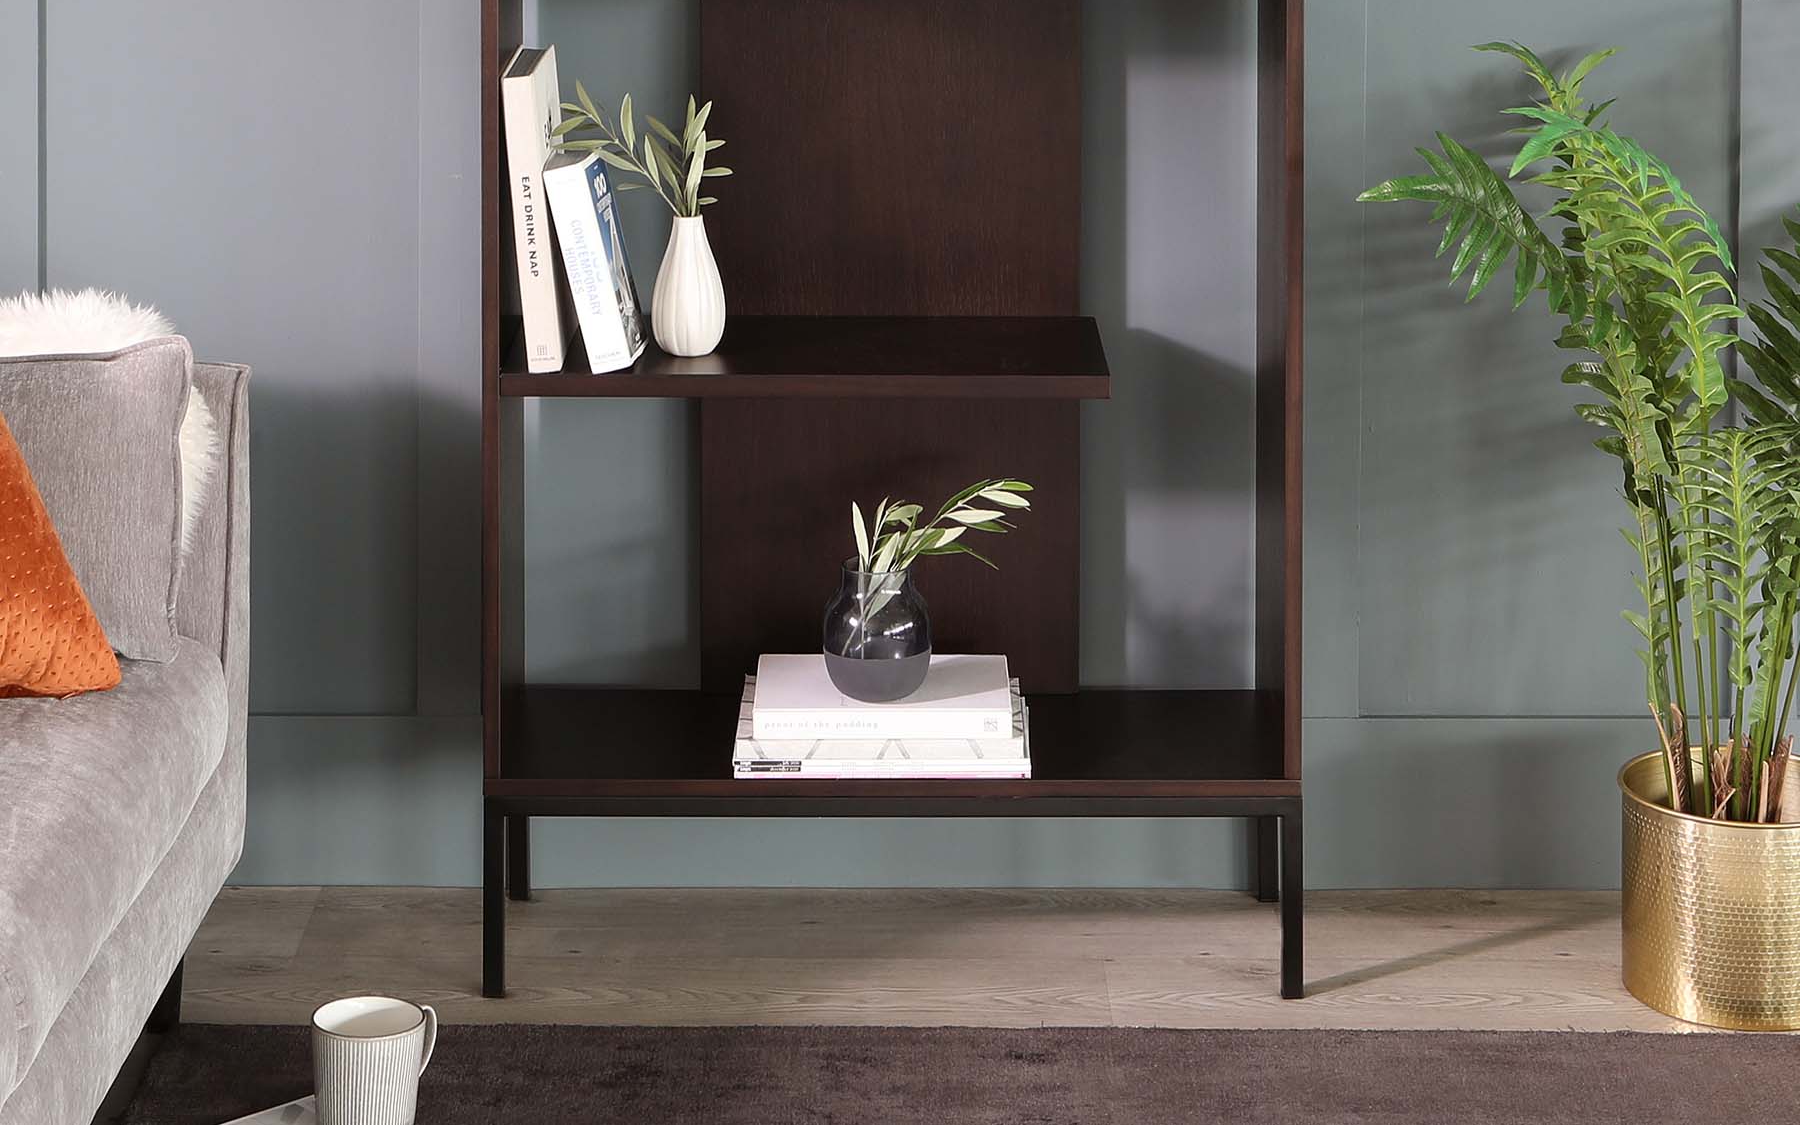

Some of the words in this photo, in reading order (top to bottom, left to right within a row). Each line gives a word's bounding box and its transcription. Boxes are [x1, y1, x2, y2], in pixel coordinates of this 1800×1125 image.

[521, 176, 532, 200] EAT
[524, 204, 536, 246] DRINK
[528, 250, 539, 278] NAP
[564, 247, 585, 294] HOUSES
[570, 219, 603, 316] CONTEMPORARY
